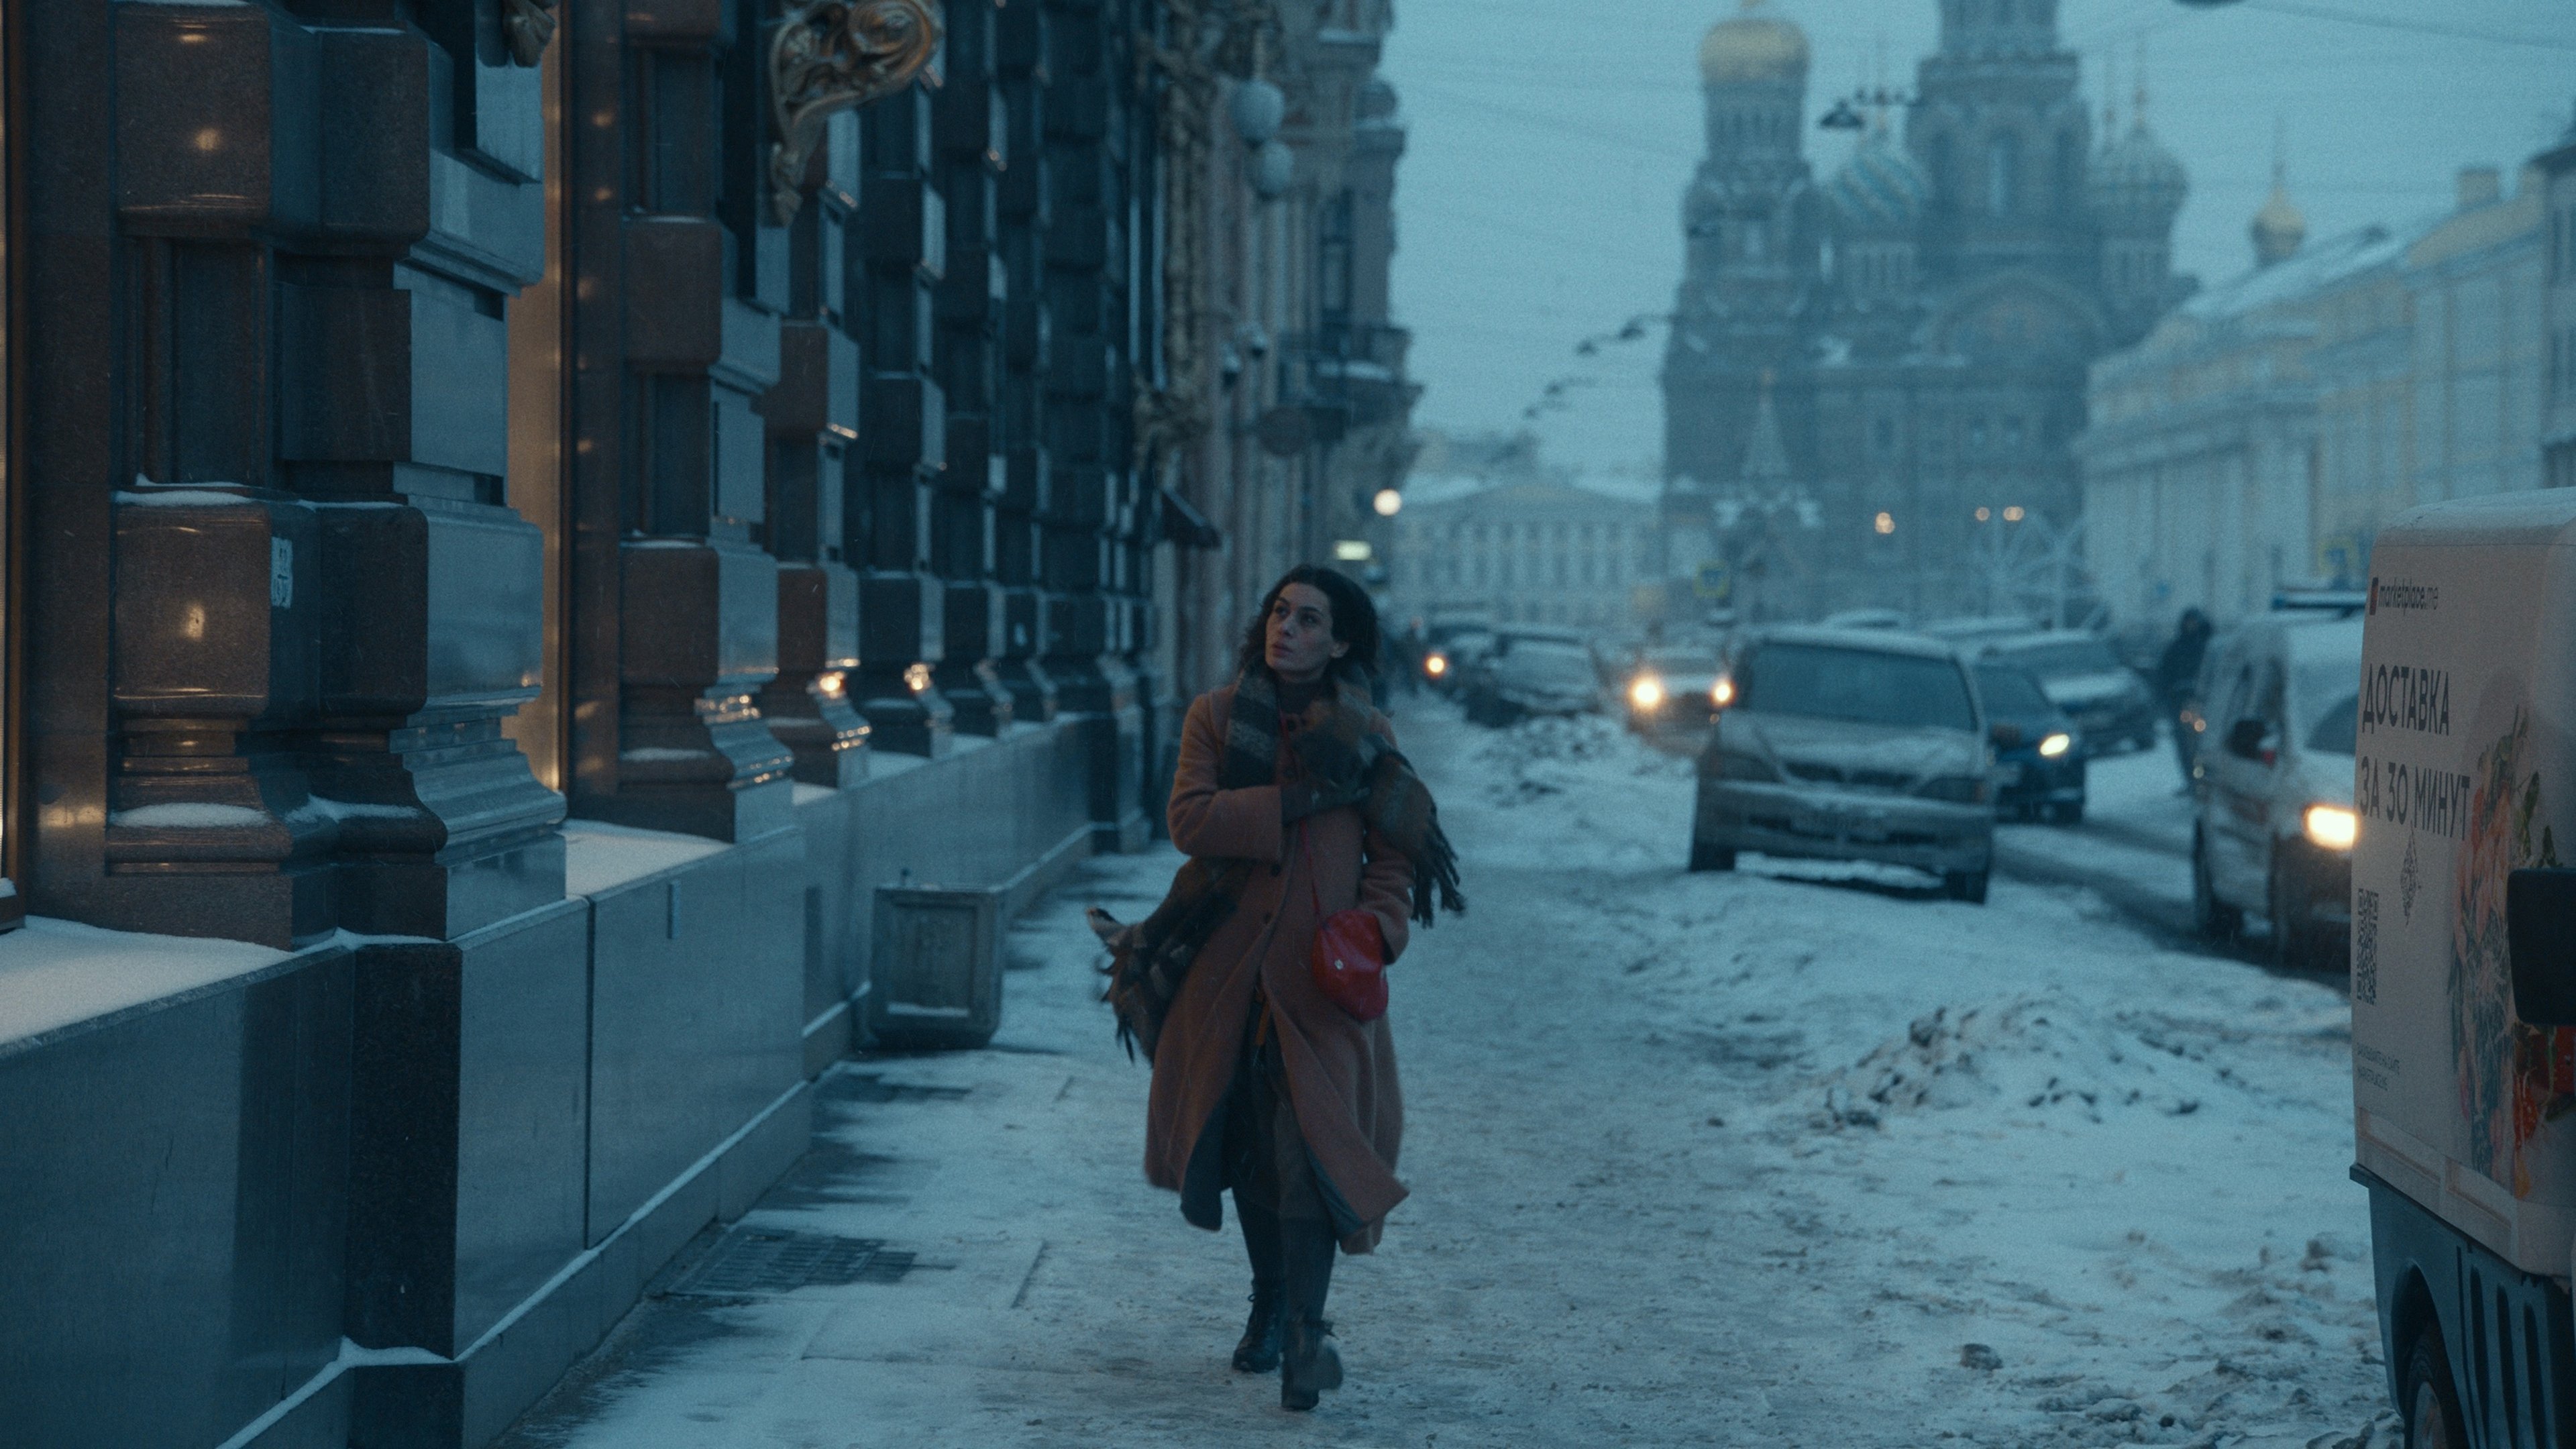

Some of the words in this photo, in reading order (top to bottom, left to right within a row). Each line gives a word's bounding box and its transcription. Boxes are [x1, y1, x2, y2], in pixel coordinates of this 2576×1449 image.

[2378, 577, 2438, 616] marketplace.me
[2363, 663, 2450, 736] ДОСТАВКА
[2359, 755, 2380, 819] ЗА
[2386, 761, 2409, 825] 30
[2414, 765, 2471, 841] МИНУТ
